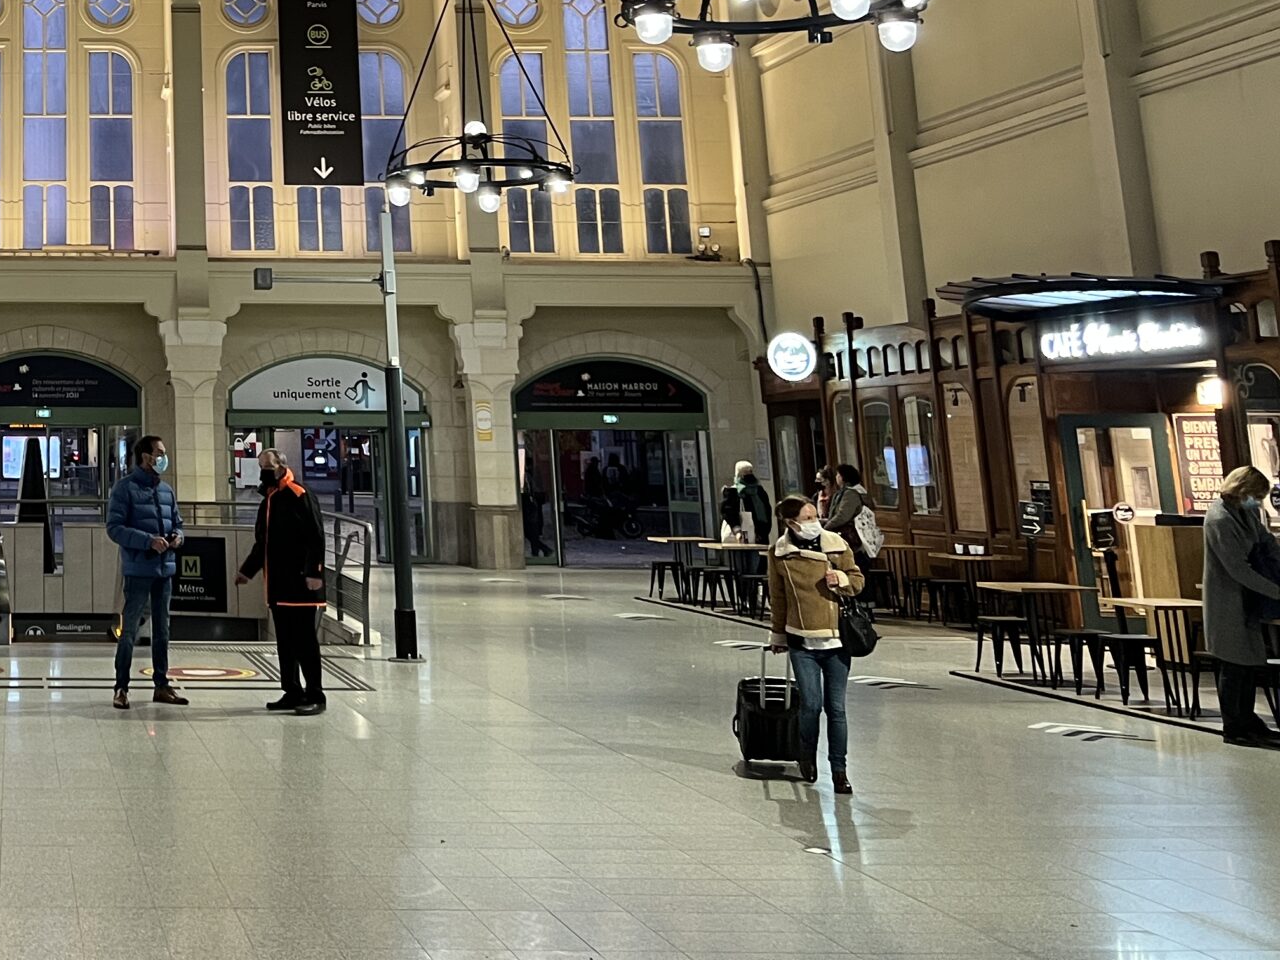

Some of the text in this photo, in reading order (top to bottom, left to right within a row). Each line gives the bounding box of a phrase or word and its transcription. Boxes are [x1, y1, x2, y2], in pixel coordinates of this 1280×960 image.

[310, 30, 326, 39] BUS
[304, 96, 337, 107] Vélos
[287, 110, 356, 121] libre service
[1040, 323, 1084, 359] CAFÉ
[307, 377, 341, 387] Sortie
[587, 382, 658, 390] MAISON MARROU
[273, 389, 341, 400] uniquement
[1182, 421, 1218, 434] BIENVE
[1185, 449, 1200, 461] UN
[1192, 492, 1211, 500] VOS
[179, 584, 205, 593] Métro
[56, 623, 91, 632] Boulingrin
